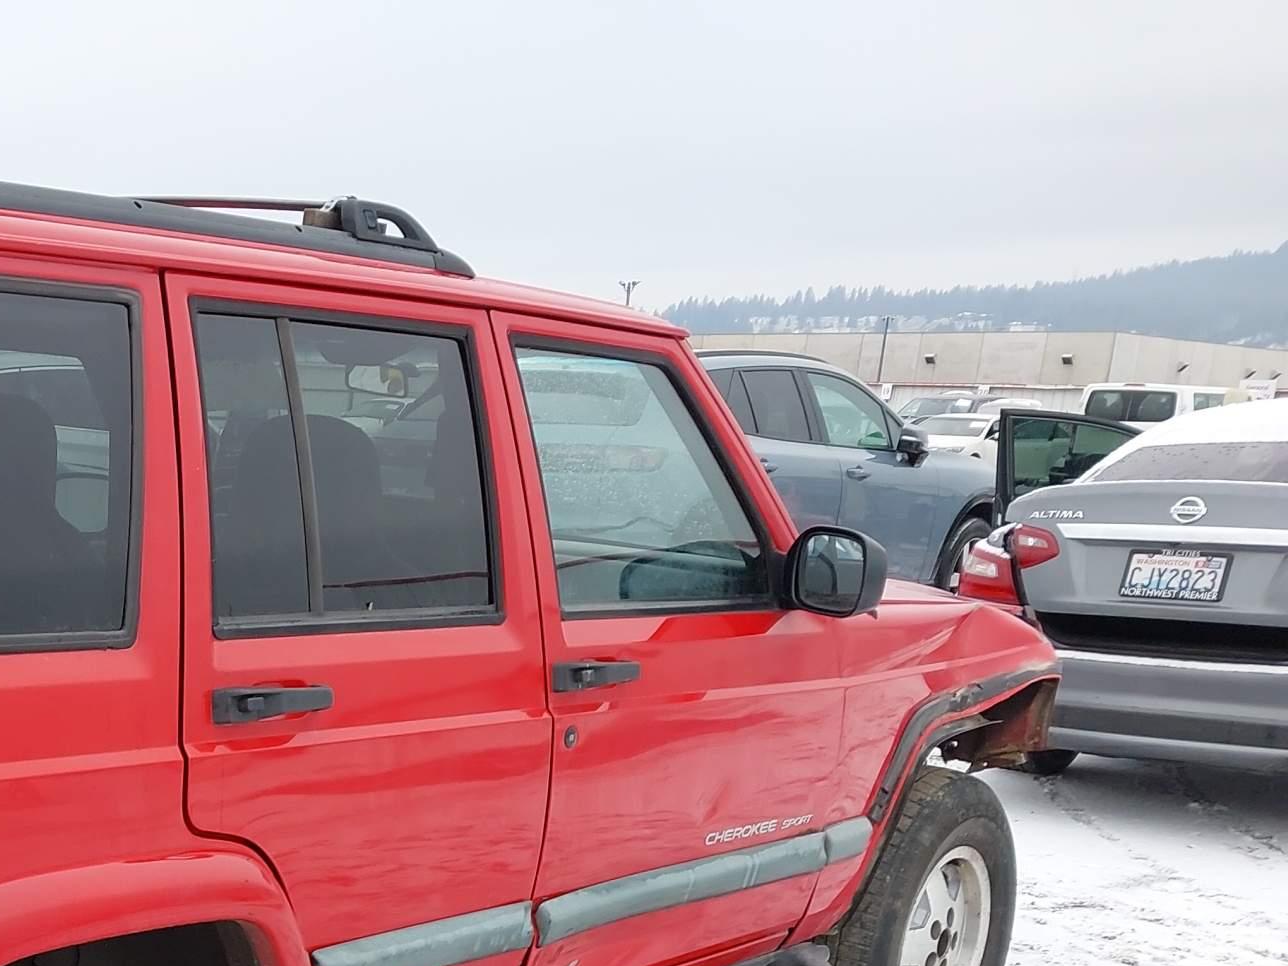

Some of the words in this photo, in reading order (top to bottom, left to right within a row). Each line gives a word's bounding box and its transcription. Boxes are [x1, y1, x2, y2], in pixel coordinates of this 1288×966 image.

[1028, 510, 1084, 519] ALTIMA
[1137, 559, 1191, 567] WASHINGTON
[1129, 567, 1217, 591] CJY2823
[1120, 587, 1177, 598] NORTHWEST
[1178, 590, 1219, 600] PREMIER
[705, 819, 778, 845] CHEROKEE
[781, 814, 814, 830] SPORT
